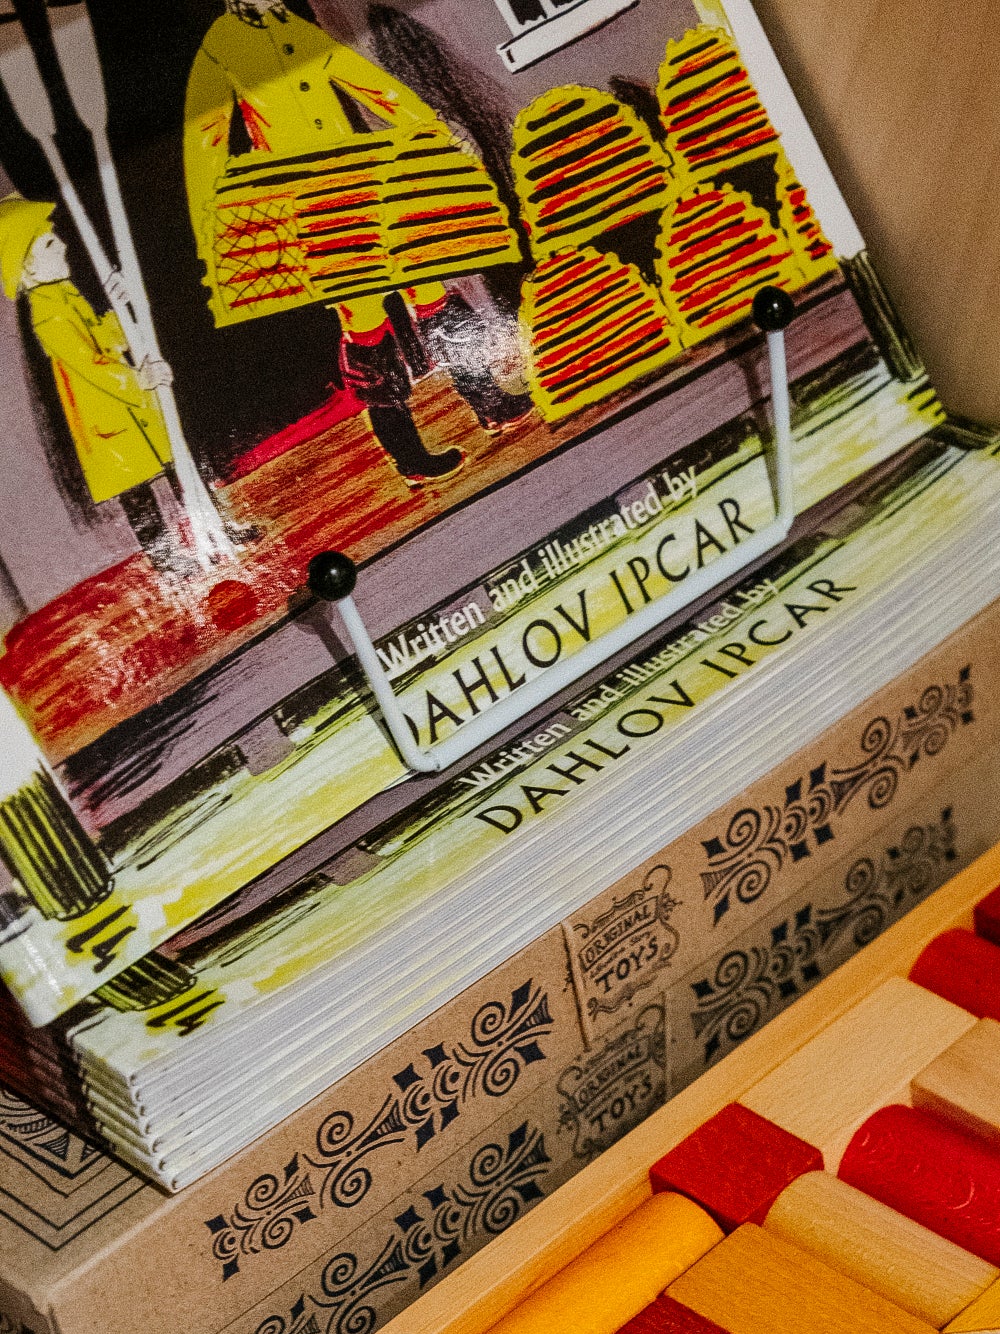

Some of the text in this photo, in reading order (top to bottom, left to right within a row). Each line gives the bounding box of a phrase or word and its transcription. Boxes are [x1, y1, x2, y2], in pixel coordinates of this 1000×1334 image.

[376, 464, 699, 674] Written and illustrated by
[610, 497, 755, 615] IPCAR
[461, 577, 780, 790] Written and illustrated by
[474, 577, 858, 835] DAHLOV IPCAR
[585, 904, 652, 965] ORIGINAL
[595, 936, 660, 993] TOYS
[590, 1073, 653, 1133] TOYS
